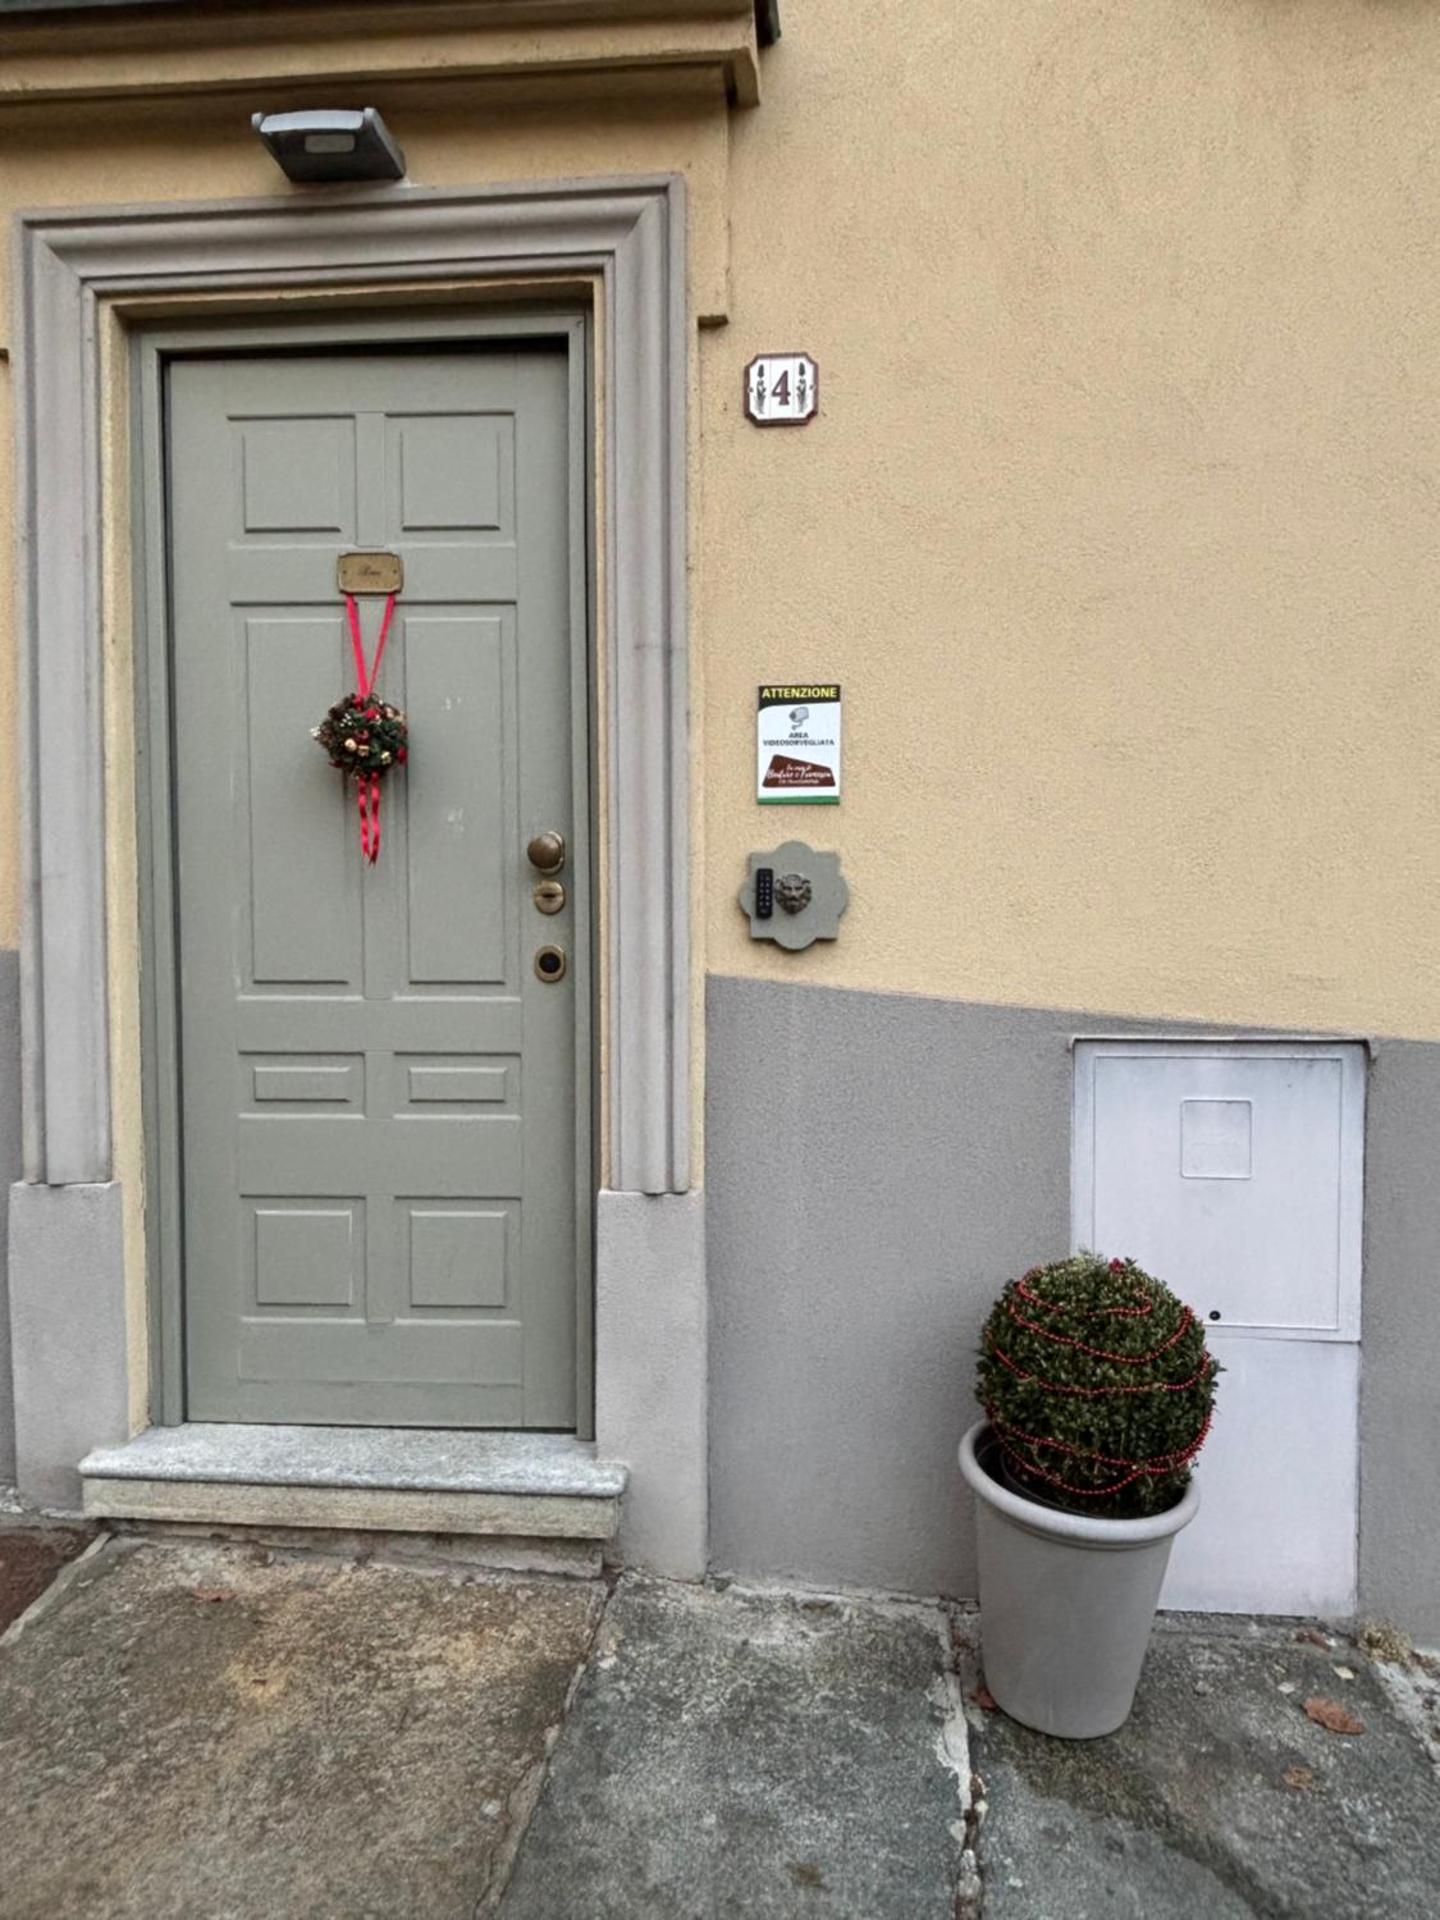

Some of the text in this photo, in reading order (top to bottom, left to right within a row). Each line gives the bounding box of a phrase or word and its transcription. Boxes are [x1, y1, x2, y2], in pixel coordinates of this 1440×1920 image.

[771, 369, 791, 406] 4
[762, 687, 838, 699] ATTENZIONE
[762, 739, 835, 747] VIDEOSORVEGLIATA
